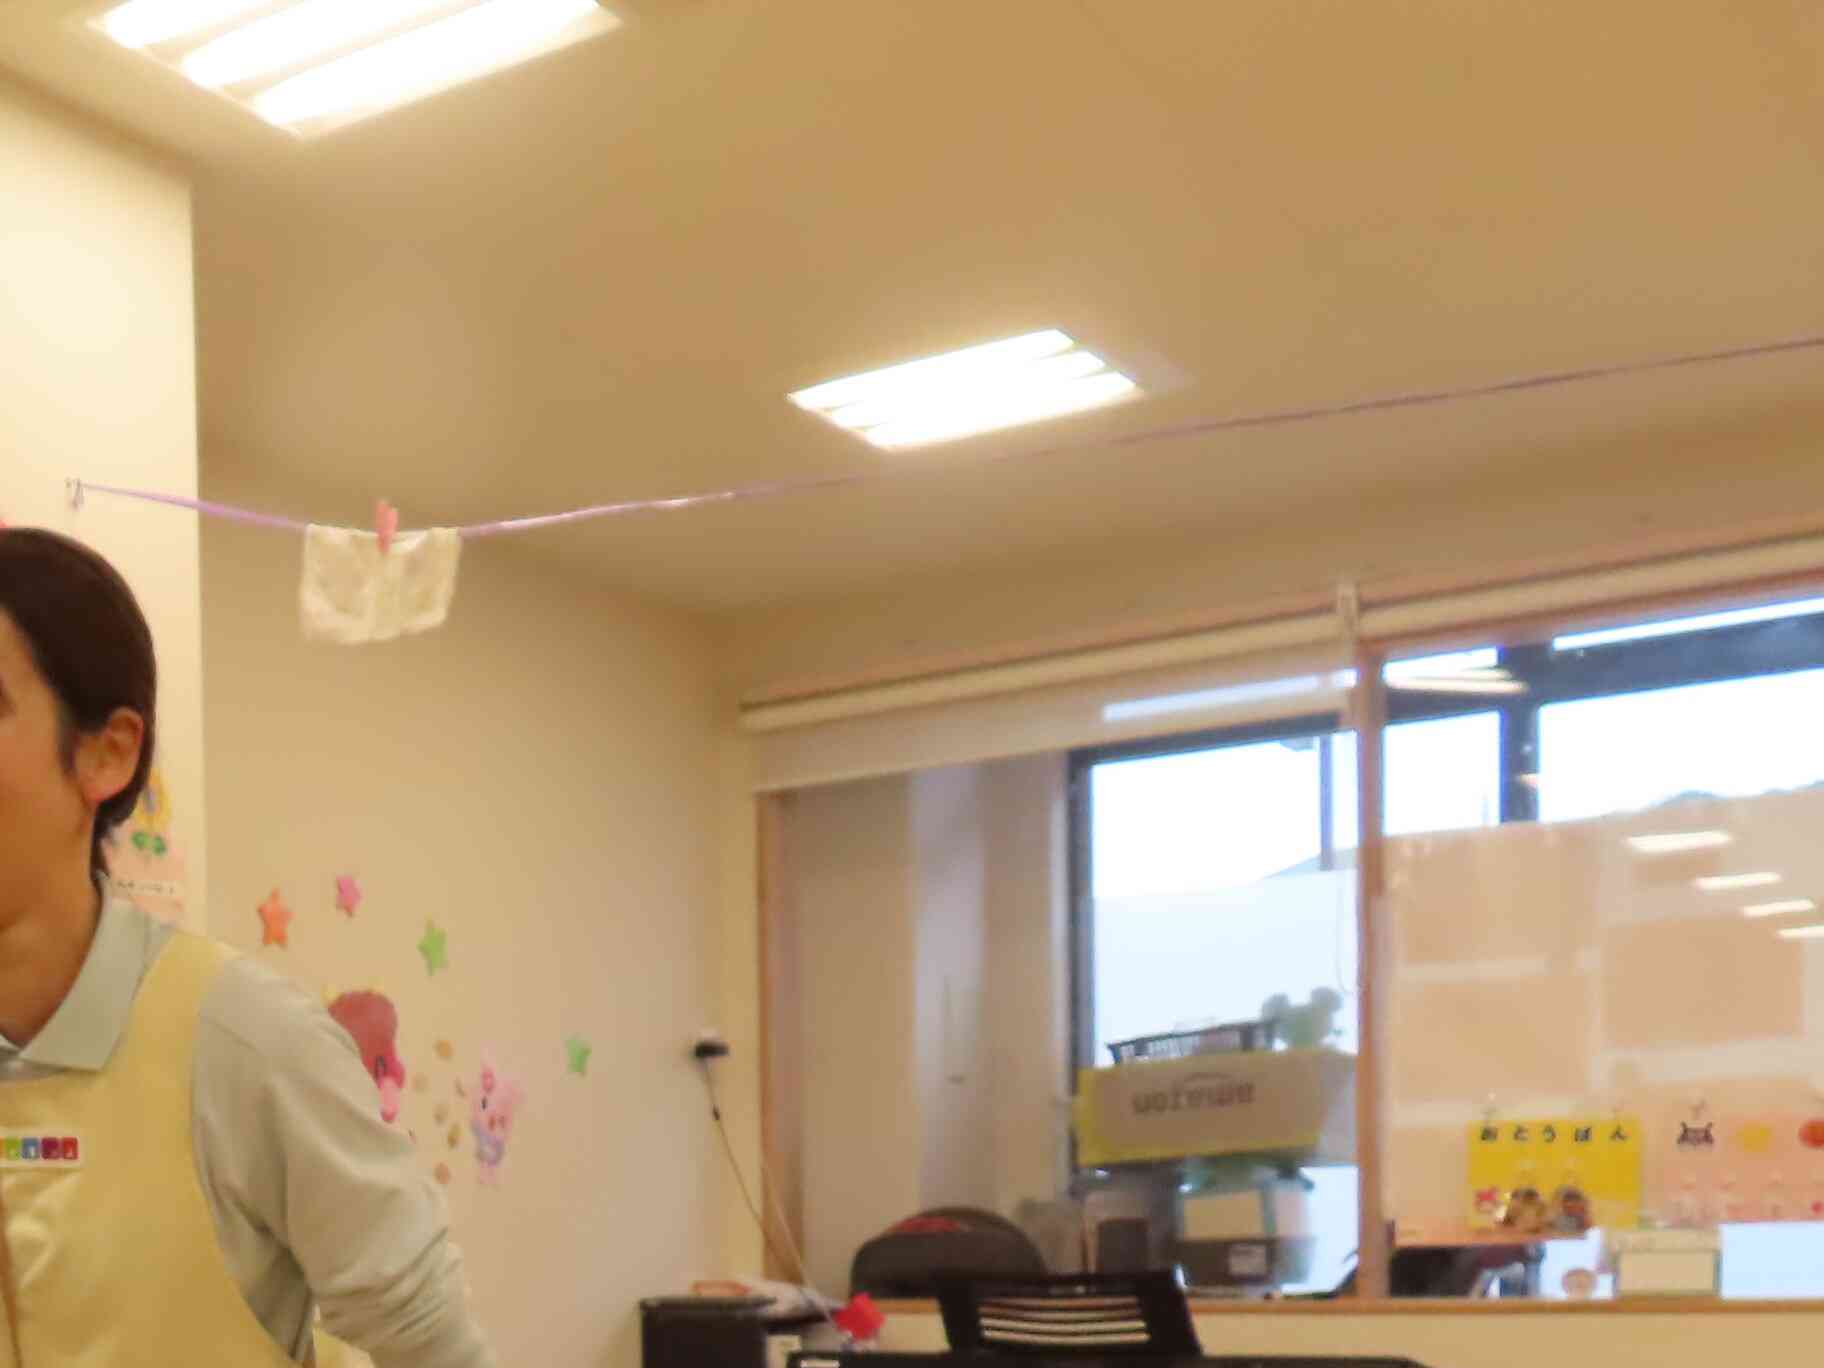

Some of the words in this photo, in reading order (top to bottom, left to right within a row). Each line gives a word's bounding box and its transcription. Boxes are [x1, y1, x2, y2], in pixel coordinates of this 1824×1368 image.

[1481, 1125, 1626, 1143] おとうばん
